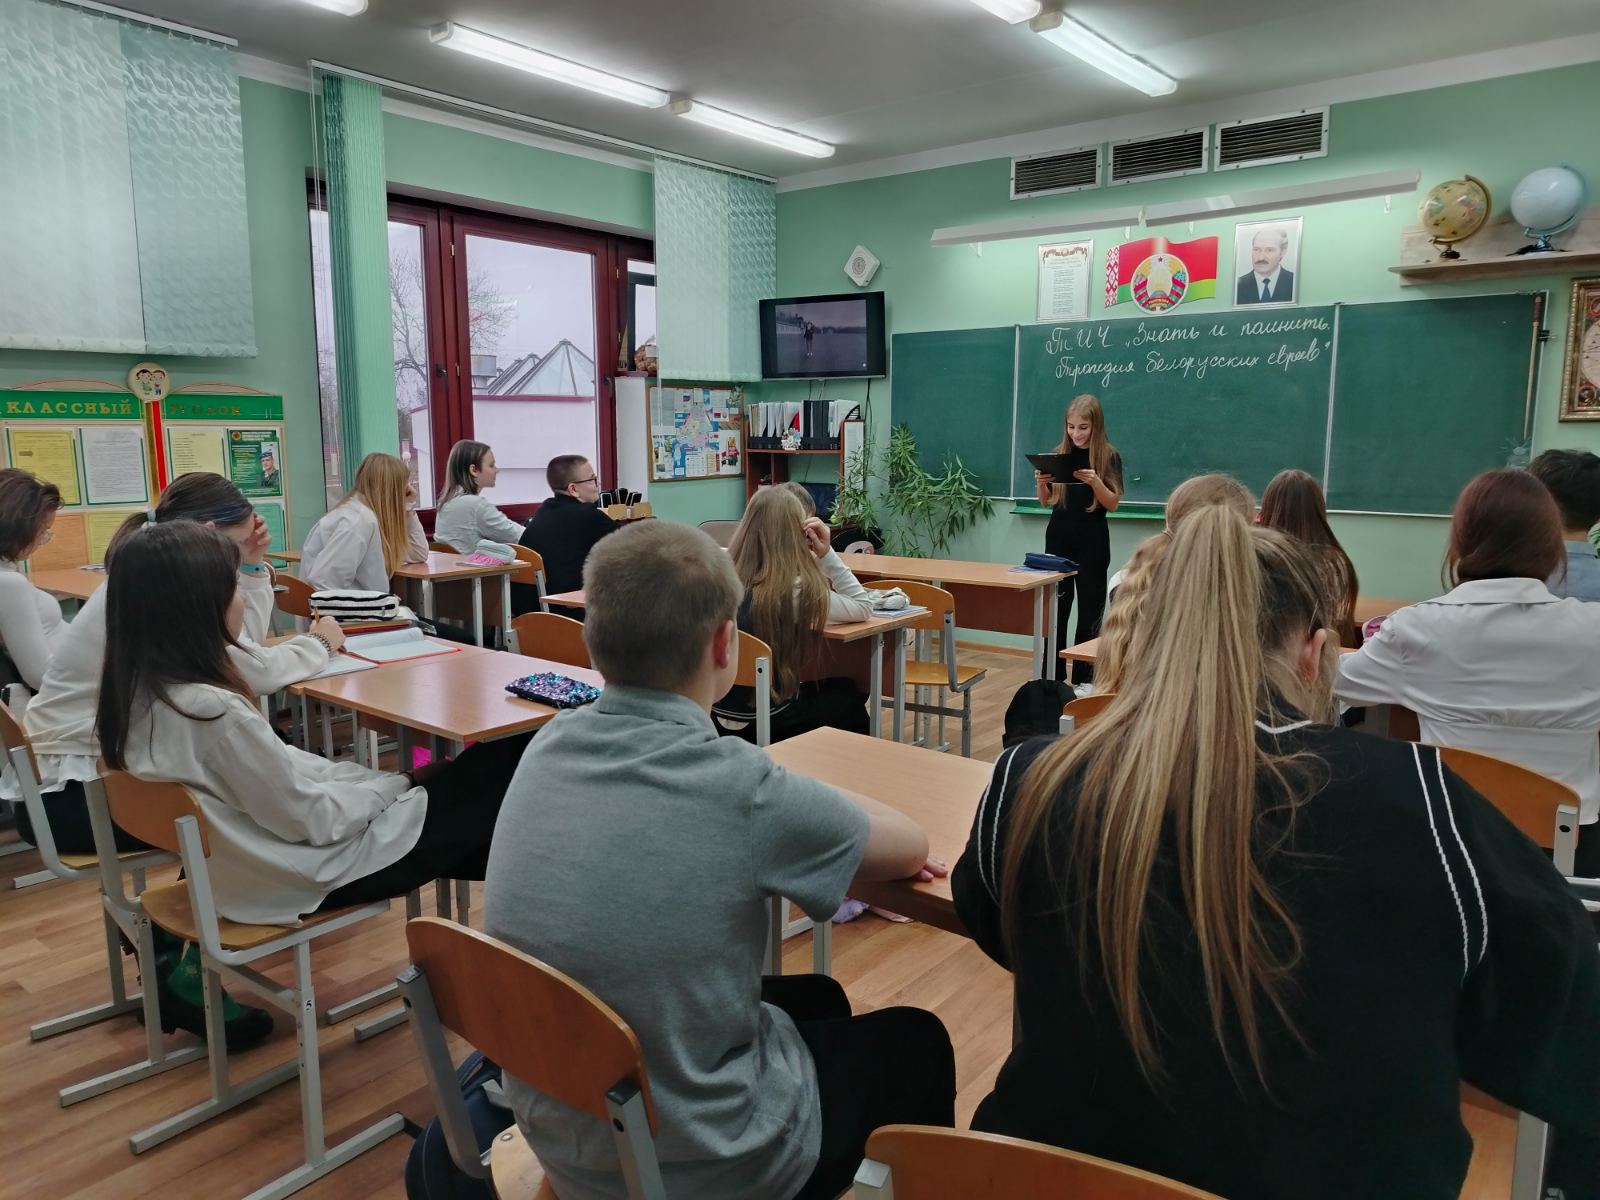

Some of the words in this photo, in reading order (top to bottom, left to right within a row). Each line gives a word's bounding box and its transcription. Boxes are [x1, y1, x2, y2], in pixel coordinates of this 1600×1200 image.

[1208, 324, 1228, 337] и
[1055, 356, 1136, 388] Трагедия
[6, 400, 132, 415] КЛАССНЫЙ
